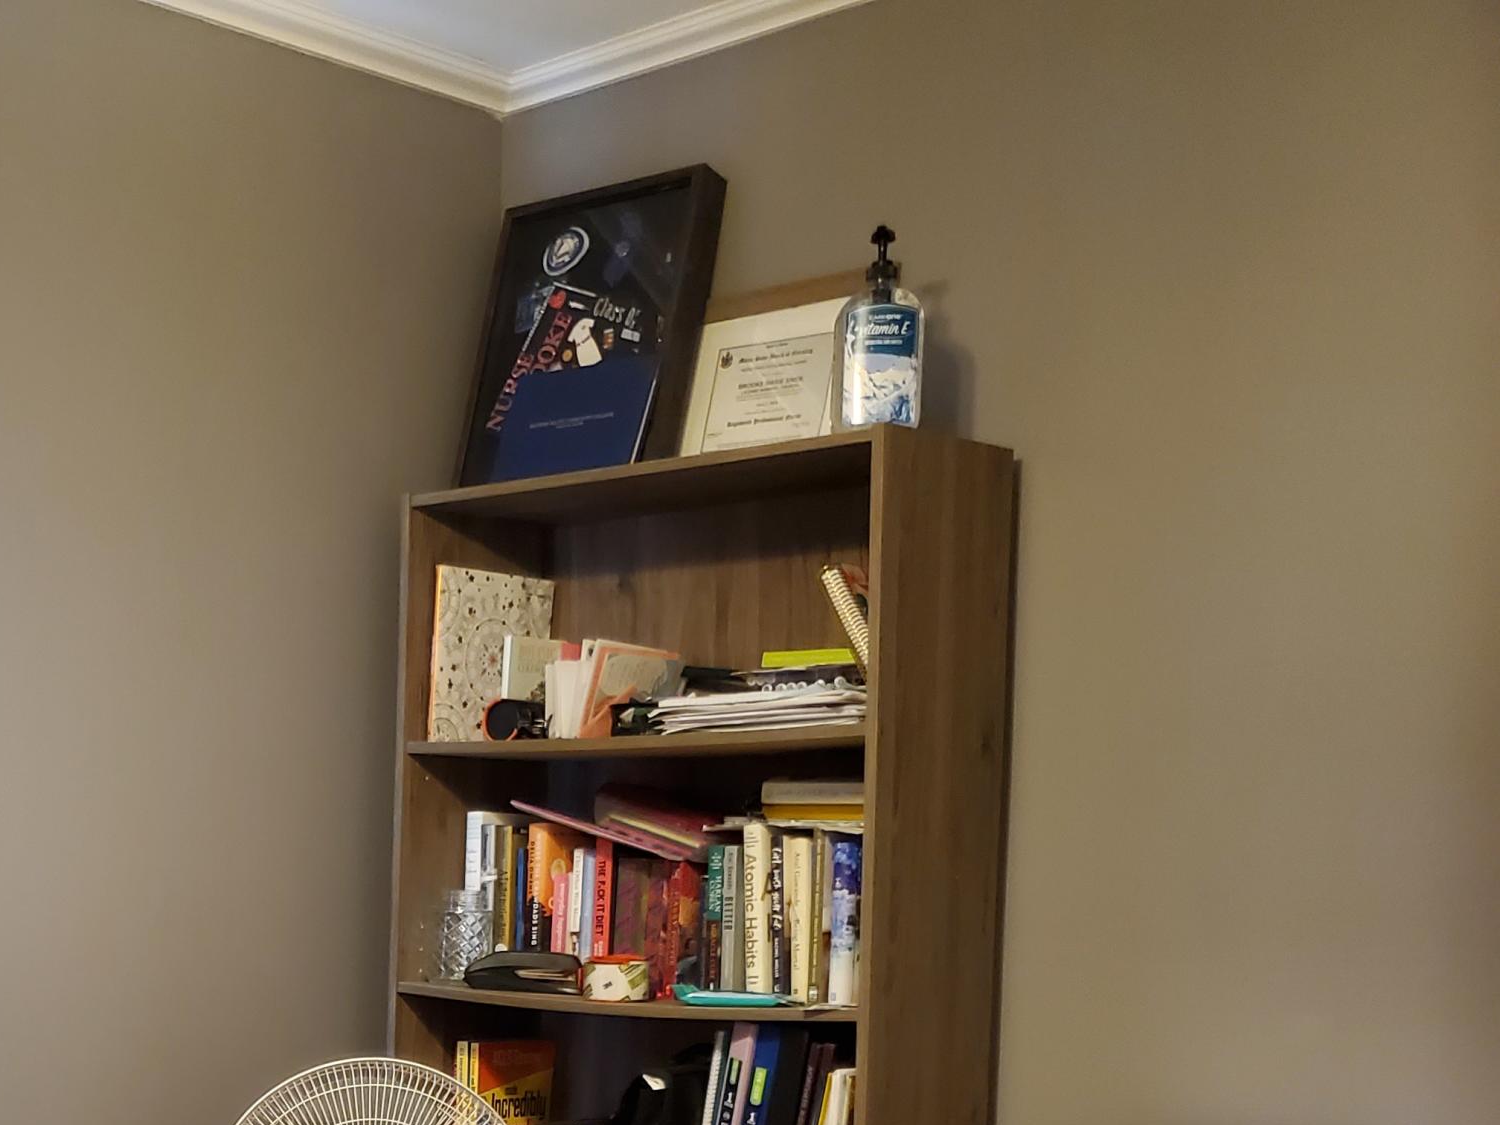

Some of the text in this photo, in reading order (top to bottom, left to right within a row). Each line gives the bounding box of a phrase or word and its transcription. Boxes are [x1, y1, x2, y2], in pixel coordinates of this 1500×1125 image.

[485, 352, 534, 431] NURSE
[598, 861, 606, 877] THE
[596, 904, 605, 913] IT
[714, 875, 722, 913] HARLAN
[595, 915, 604, 936] DIET
[723, 896, 733, 931] BETTER
[744, 854, 758, 969] Atomic Habits
[530, 927, 539, 946] SING
[491, 1090, 547, 1120] Incredibly
